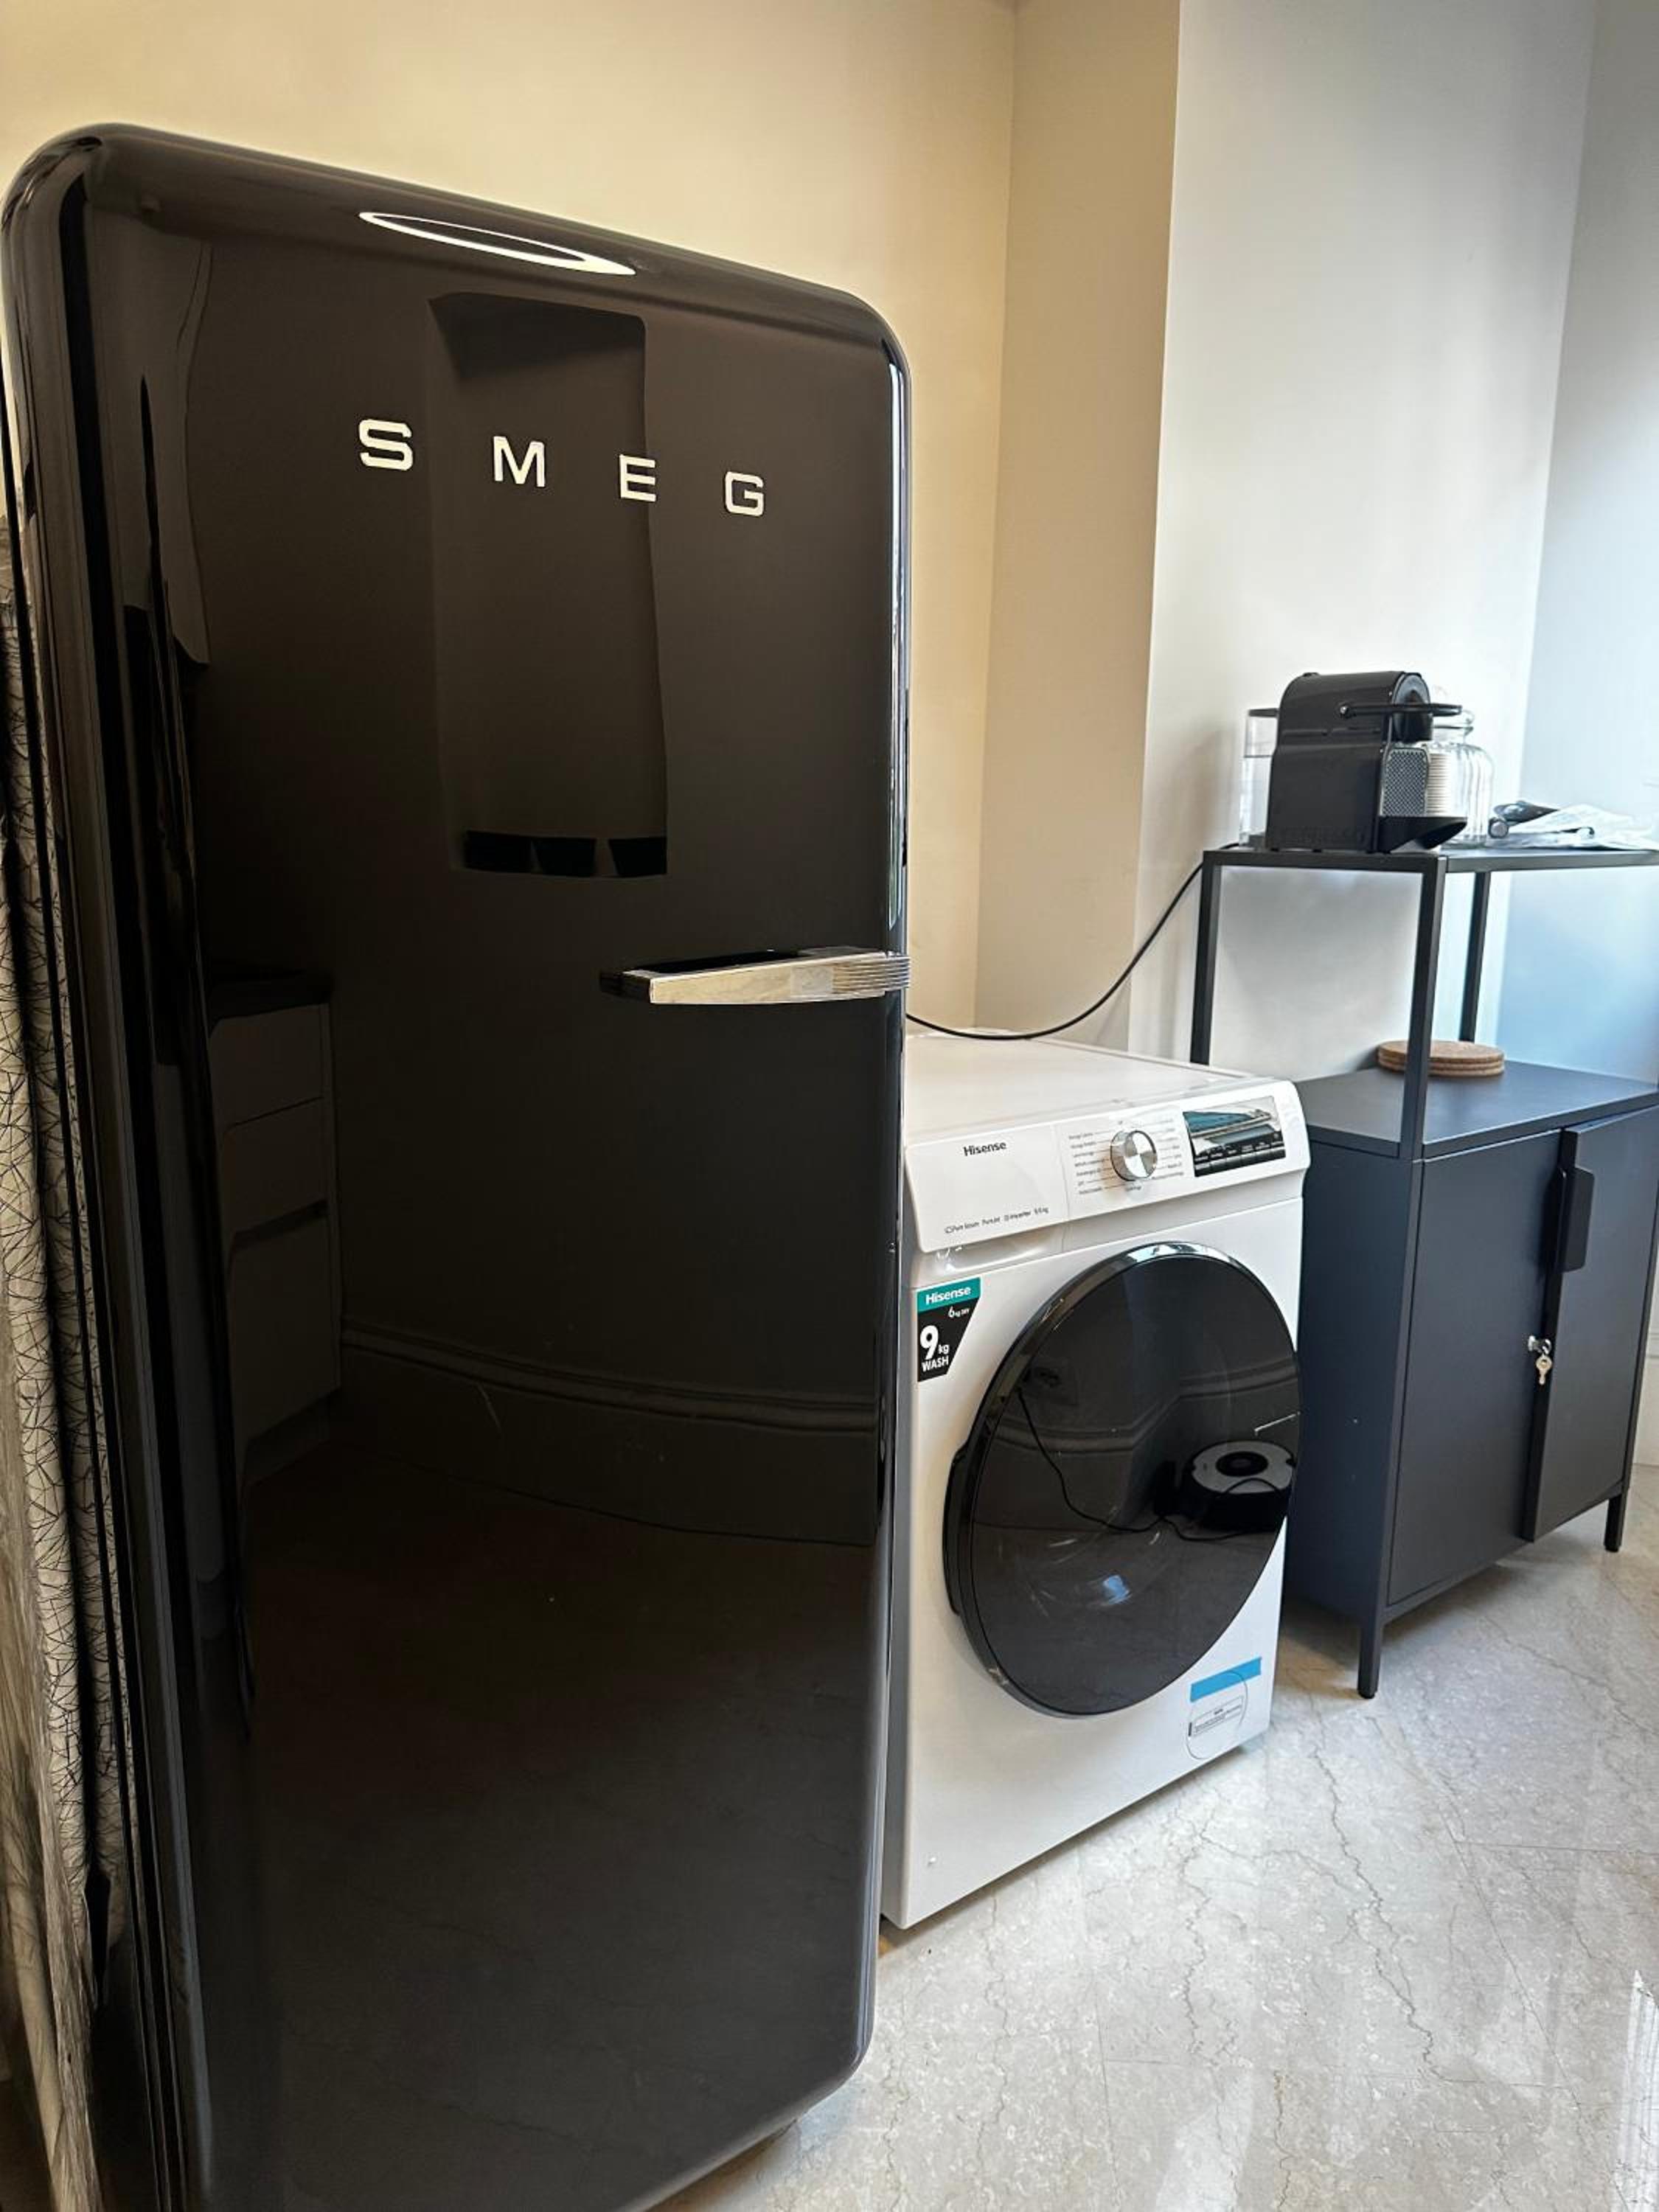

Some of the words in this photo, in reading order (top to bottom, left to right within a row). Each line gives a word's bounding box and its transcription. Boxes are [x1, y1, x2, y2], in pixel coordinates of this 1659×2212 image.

[358, 419, 765, 517] SMEG
[963, 1141, 1007, 1157] Hisense
[925, 1287, 972, 1305] Hisense
[922, 1355, 949, 1372] WASH
